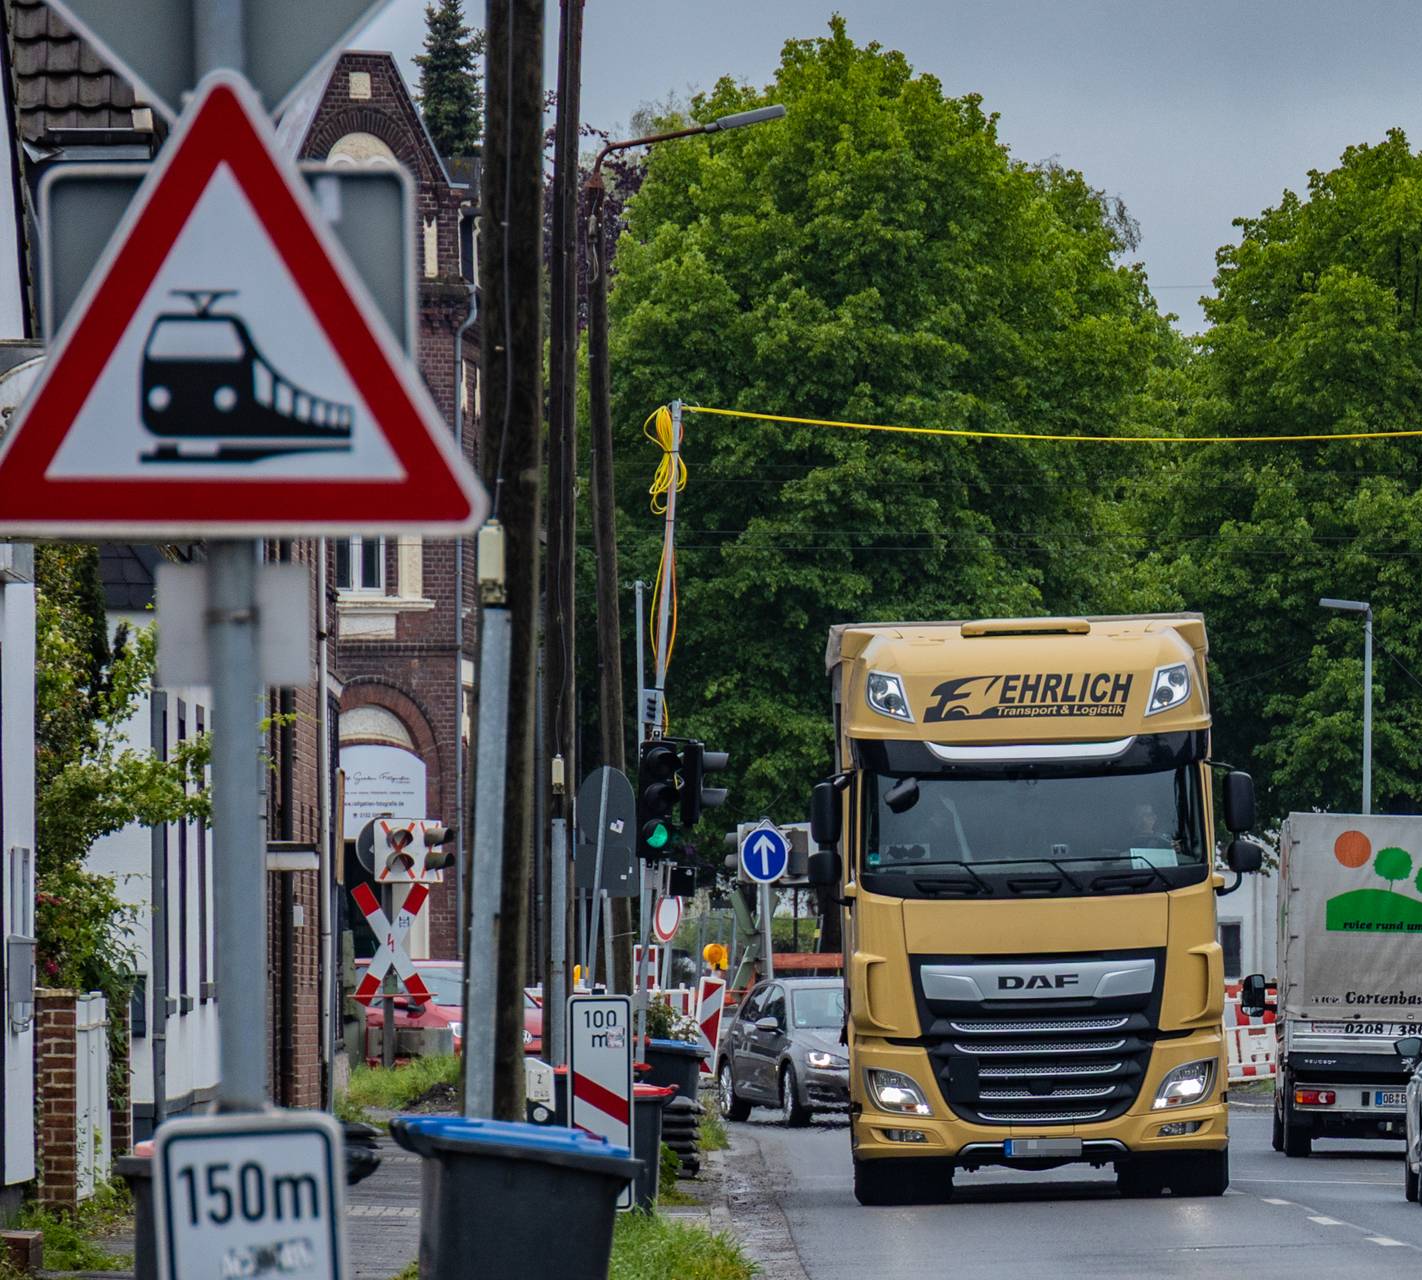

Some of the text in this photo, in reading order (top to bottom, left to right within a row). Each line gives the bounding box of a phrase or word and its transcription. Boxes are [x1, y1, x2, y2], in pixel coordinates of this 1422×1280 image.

[999, 673, 1133, 704] EHRLICH
[998, 704, 1124, 717] Transport & Logistik
[1376, 921, 1403, 930] rund
[997, 973, 1079, 990] DAF
[584, 1010, 617, 1028] 100
[1345, 1023, 1383, 1035] 0208
[592, 1033, 608, 1047] m
[178, 1160, 320, 1227] 150m
